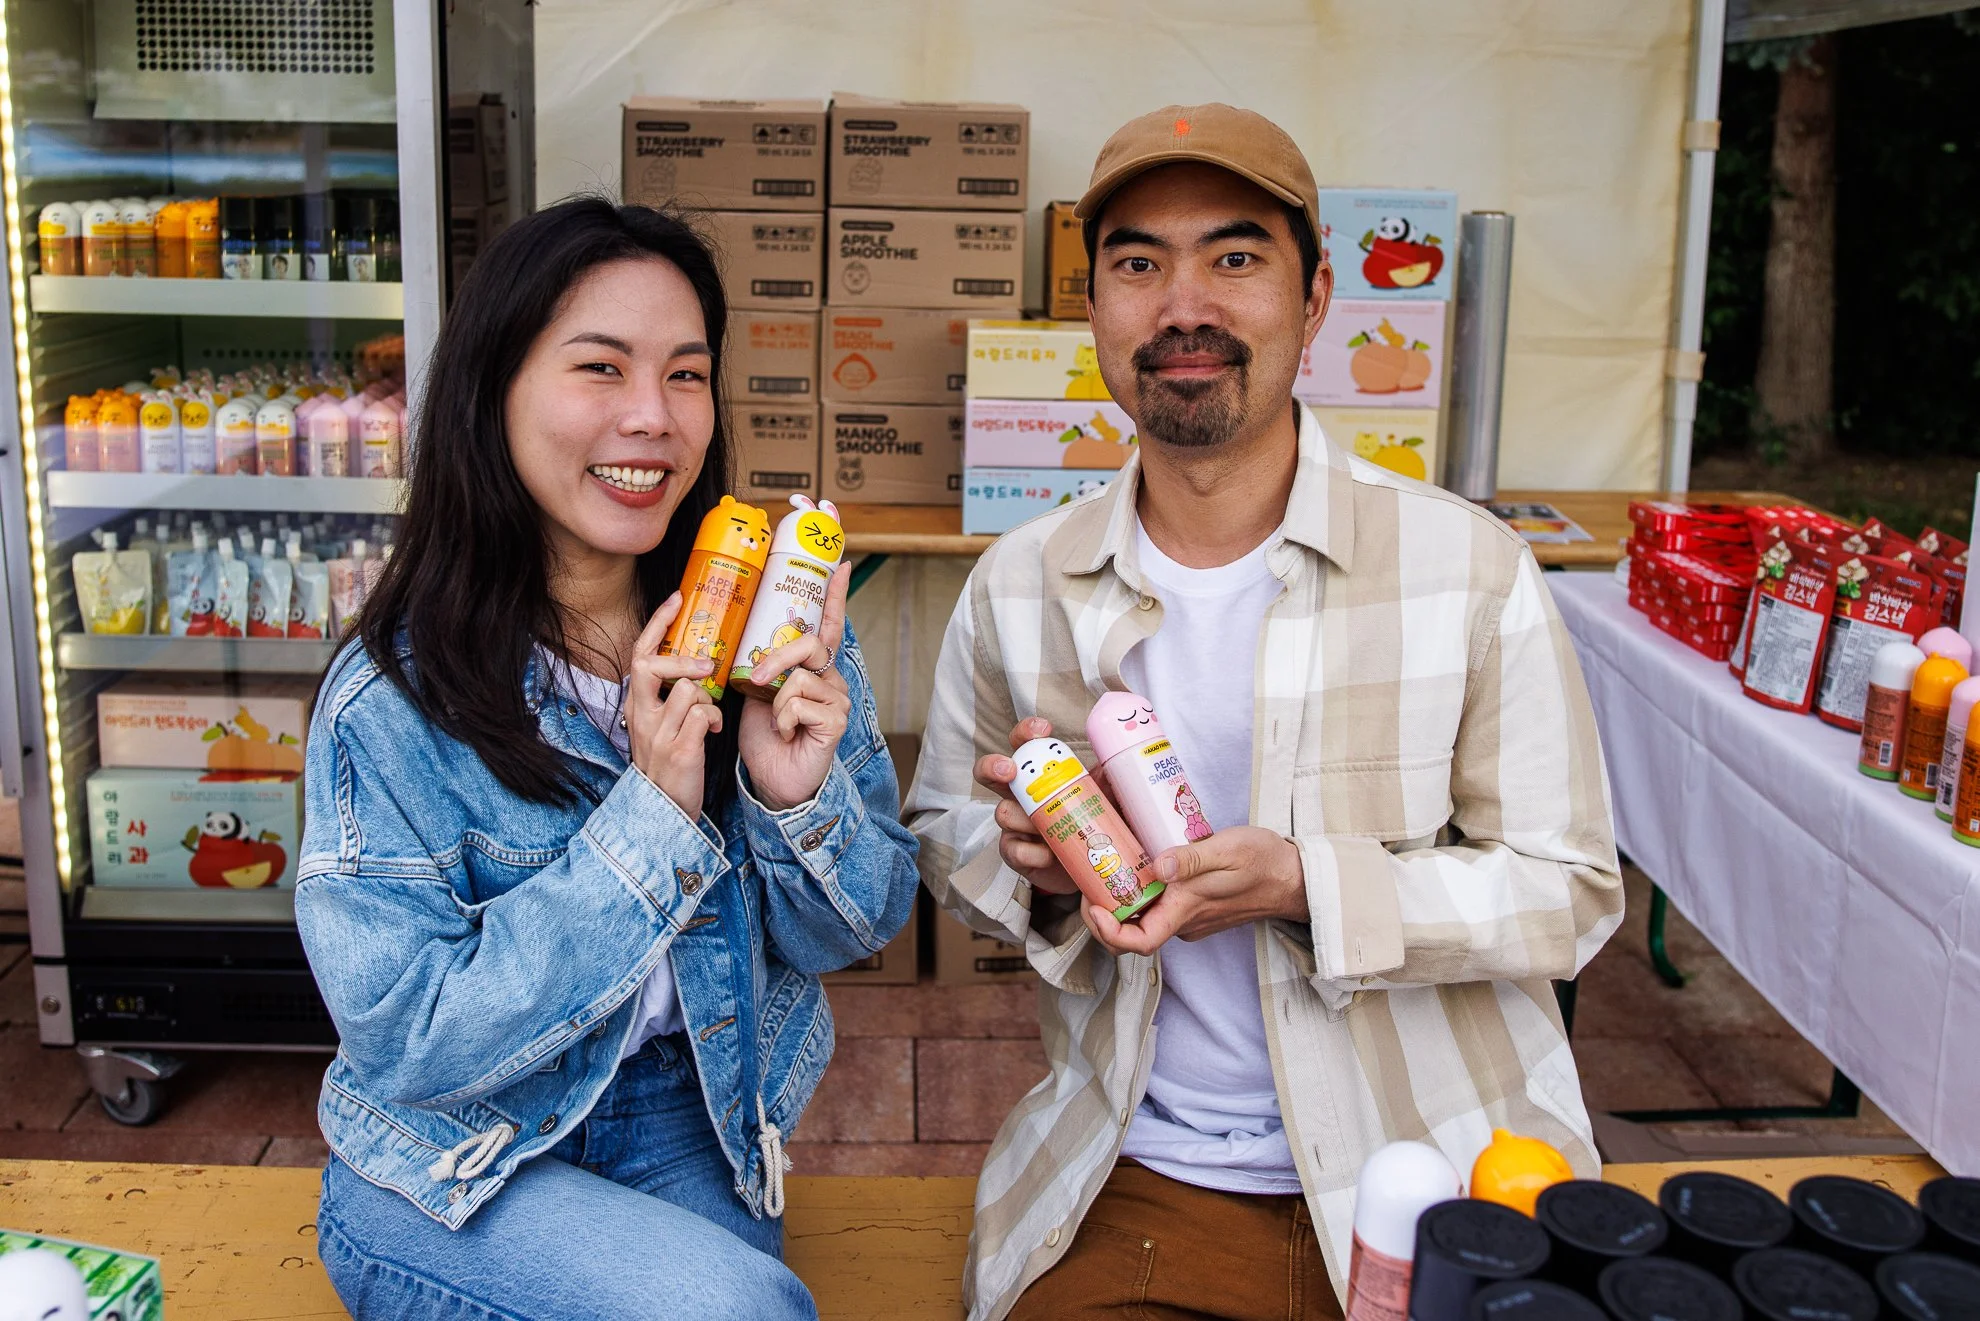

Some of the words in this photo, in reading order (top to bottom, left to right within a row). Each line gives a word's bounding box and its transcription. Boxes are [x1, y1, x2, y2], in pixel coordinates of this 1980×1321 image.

[636, 136, 725, 148] STRAWBERRY
[843, 135, 931, 147] STRAWBERRY
[636, 148, 704, 158] SMOOTHIE
[843, 147, 911, 157] SMOOTHIE
[840, 234, 888, 247] APPLE
[840, 247, 919, 260] SMOOTHIE
[833, 331, 873, 341] PEACH
[833, 341, 894, 351] SMOOTHIE
[835, 427, 898, 441] MANGO
[835, 441, 924, 455] SMOOTHIE
[710, 559, 730, 569] KAKAO
[729, 564, 750, 576] FRIENDS
[789, 560, 809, 569] KAKAO
[808, 564, 827, 577] FRIENDS
[707, 575, 742, 594] APPLE
[785, 574, 823, 595] MANGO
[694, 582, 747, 607] SMOOTHIE
[774, 582, 824, 608] SMOOTHIE
[1784, 583, 1818, 609] 김스낵
[1869, 591, 1913, 613] 바삭바삭
[708, 596, 734, 612] 라이언
[792, 598, 808, 611] 무지
[1864, 603, 1906, 629] 김스낵
[1143, 744, 1161, 755] KAKAO
[1148, 764, 1185, 785] SMOOTH
[1046, 800, 1062, 813] KAKAO
[1060, 786, 1081, 803] FRIENDS
[1057, 804, 1106, 843] SMOOTHIE
[1077, 824, 1096, 841] 튜브
